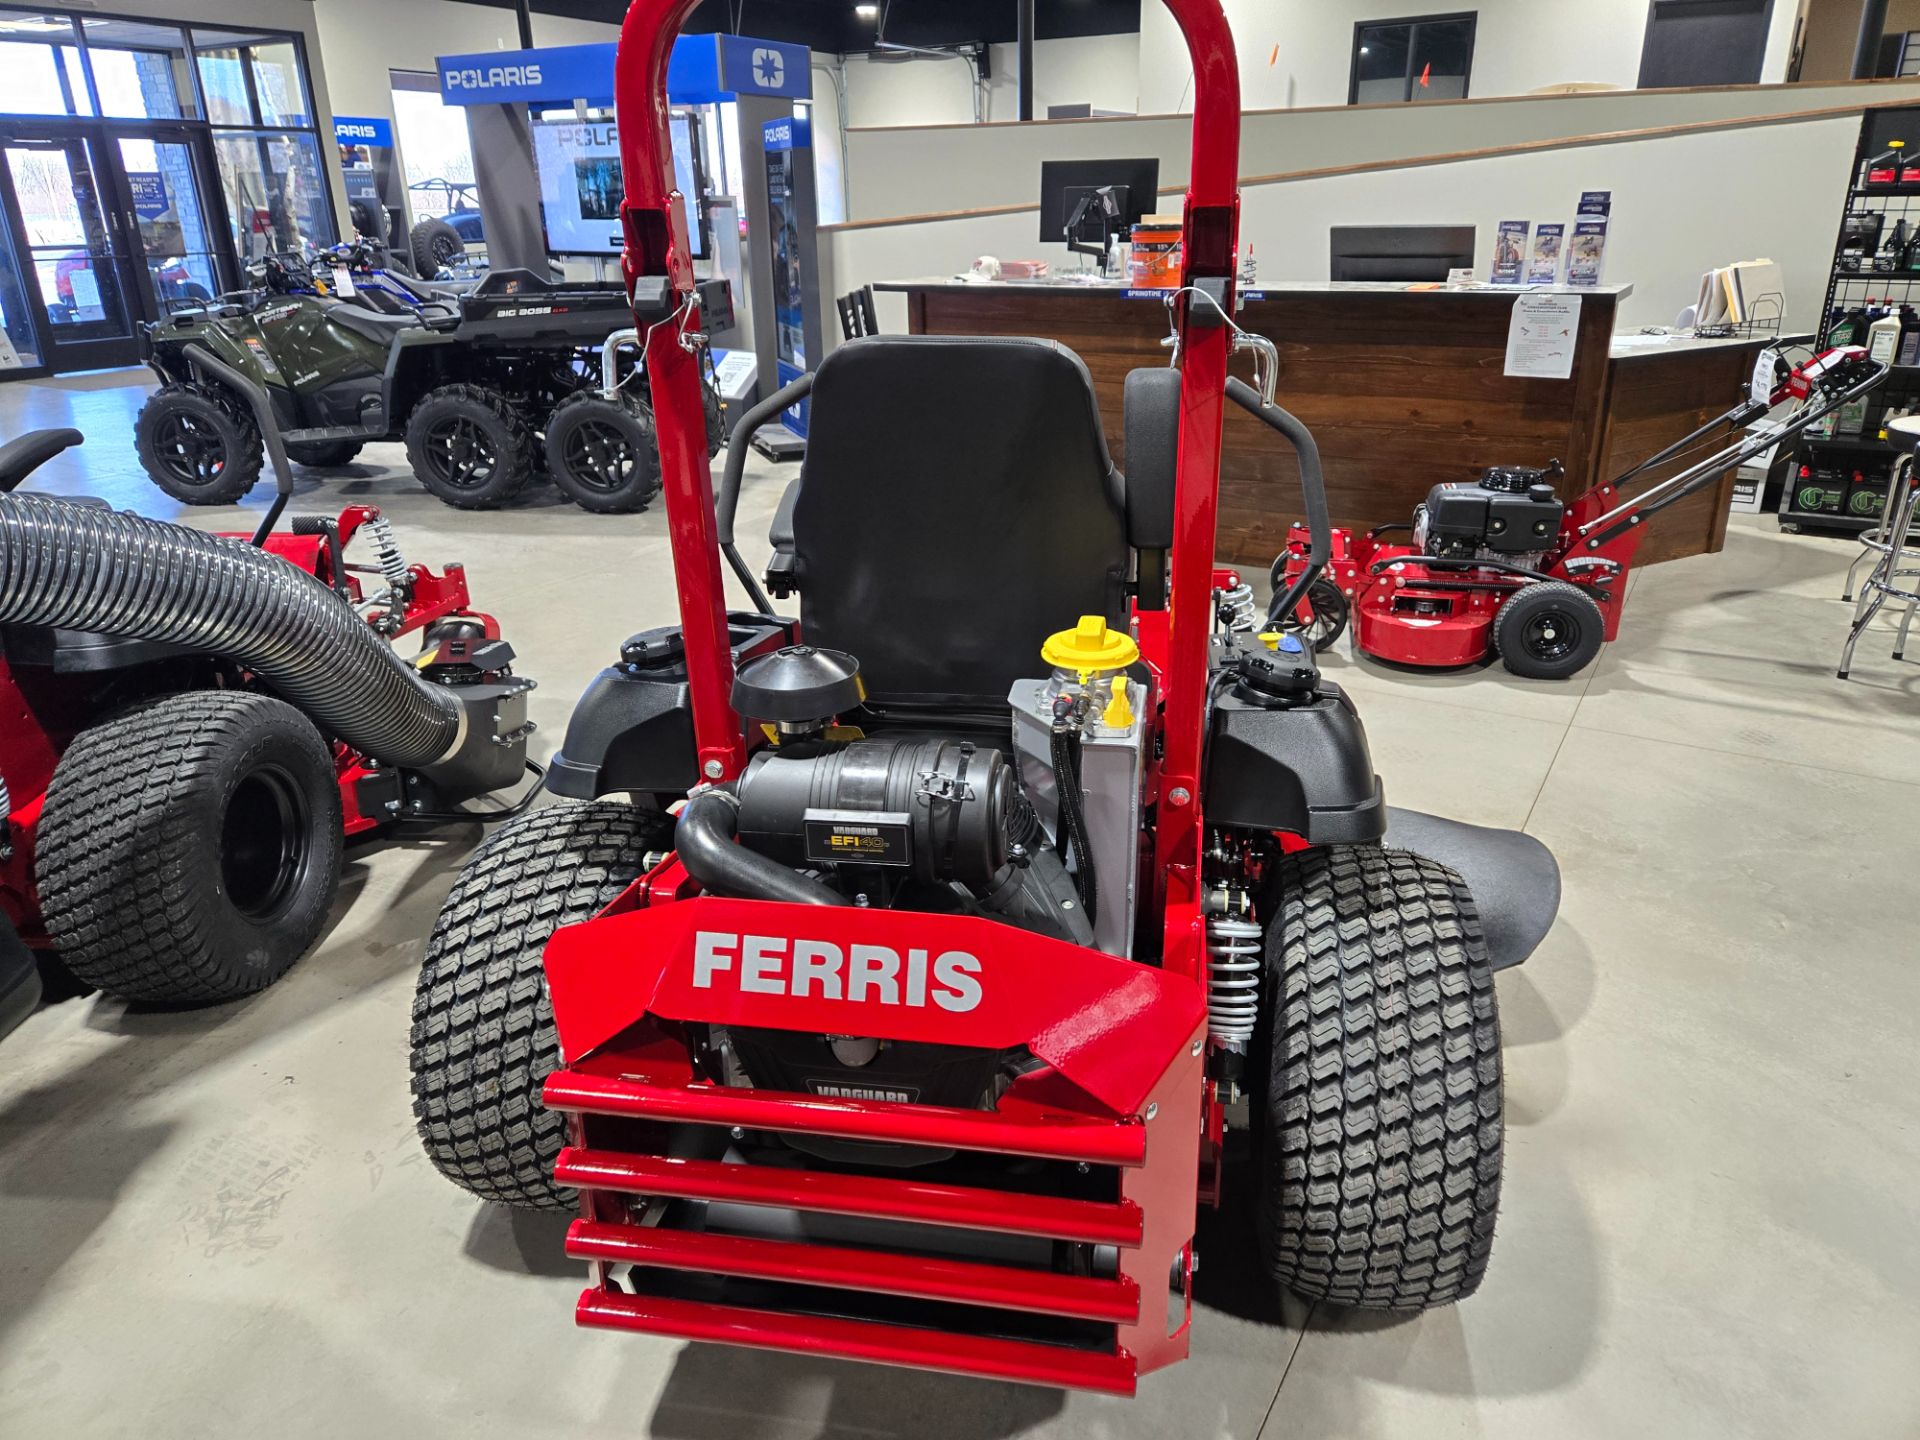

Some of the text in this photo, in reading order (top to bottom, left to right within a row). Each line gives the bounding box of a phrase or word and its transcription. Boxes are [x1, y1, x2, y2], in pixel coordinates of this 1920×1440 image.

[445, 65, 543, 90] POLARIS
[335, 124, 376, 138] ARIS
[557, 127, 618, 147] POLA
[764, 125, 790, 143] POLARIS
[497, 310, 516, 318] BIG
[518, 306, 552, 315] BOSS
[833, 826, 879, 836] VANGUARD
[692, 931, 983, 1013] FERRIS
[817, 1086, 908, 1104] VANGUARD
